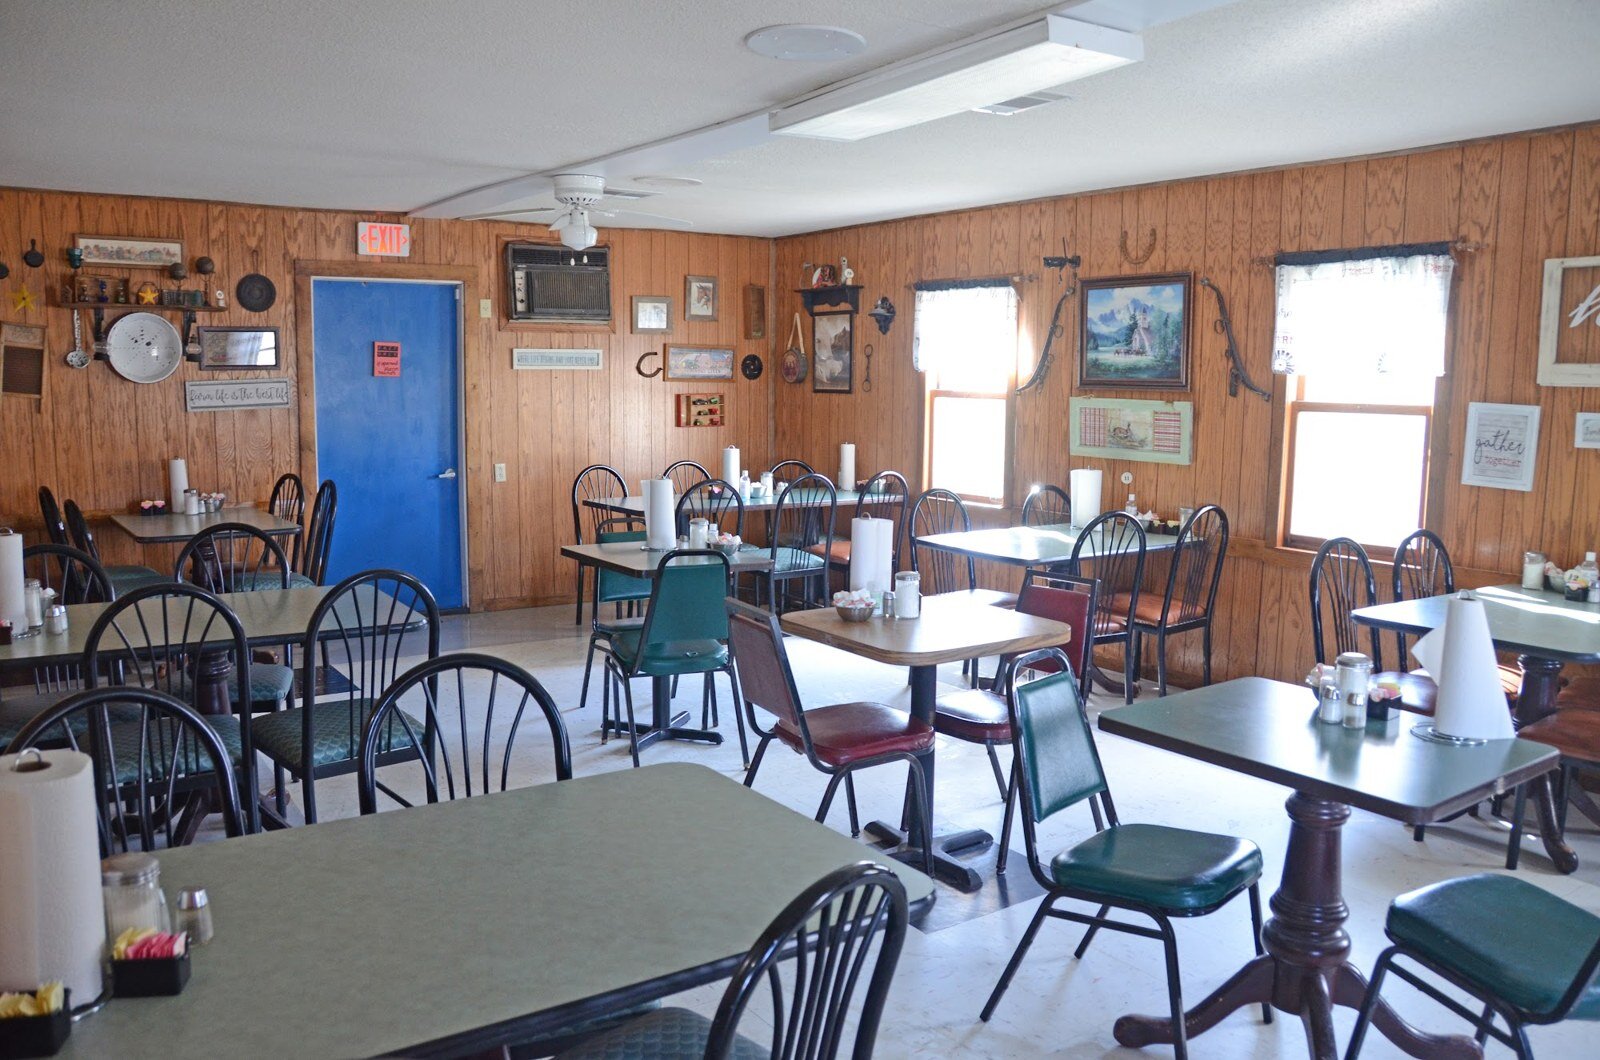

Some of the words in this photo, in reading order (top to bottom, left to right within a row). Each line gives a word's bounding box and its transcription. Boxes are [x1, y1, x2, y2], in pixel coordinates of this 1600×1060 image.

[368, 225, 402, 253] EXIT
[216, 389, 230, 403] life
[256, 386, 275, 400] best
[1474, 430, 1526, 464] gather
